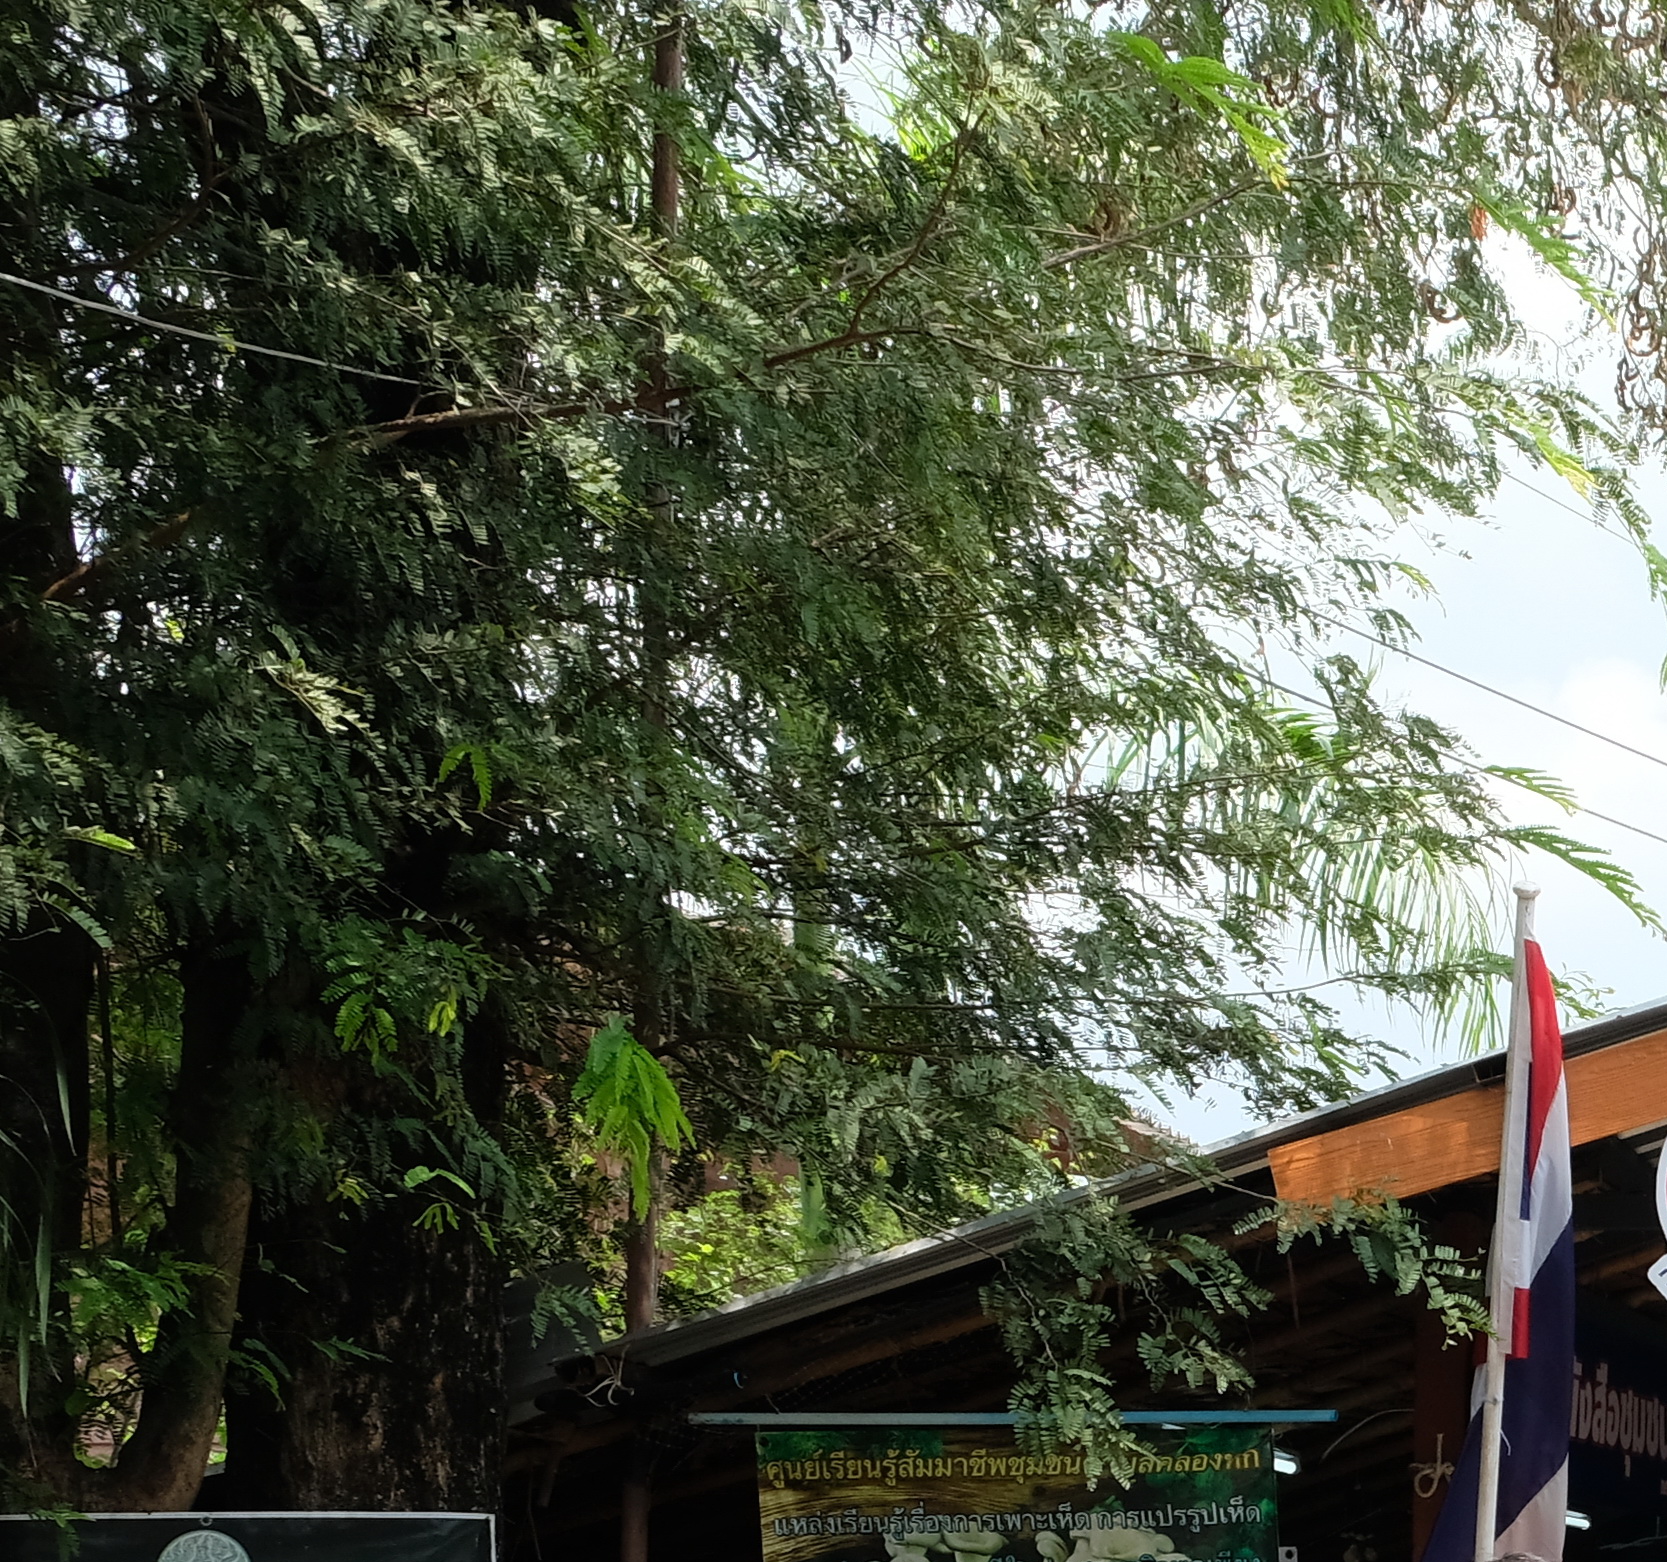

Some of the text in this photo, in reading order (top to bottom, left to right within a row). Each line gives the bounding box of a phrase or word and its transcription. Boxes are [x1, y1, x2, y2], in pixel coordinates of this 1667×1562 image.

[1097, 1496, 1262, 1534] การแปรรูปเห็ด
